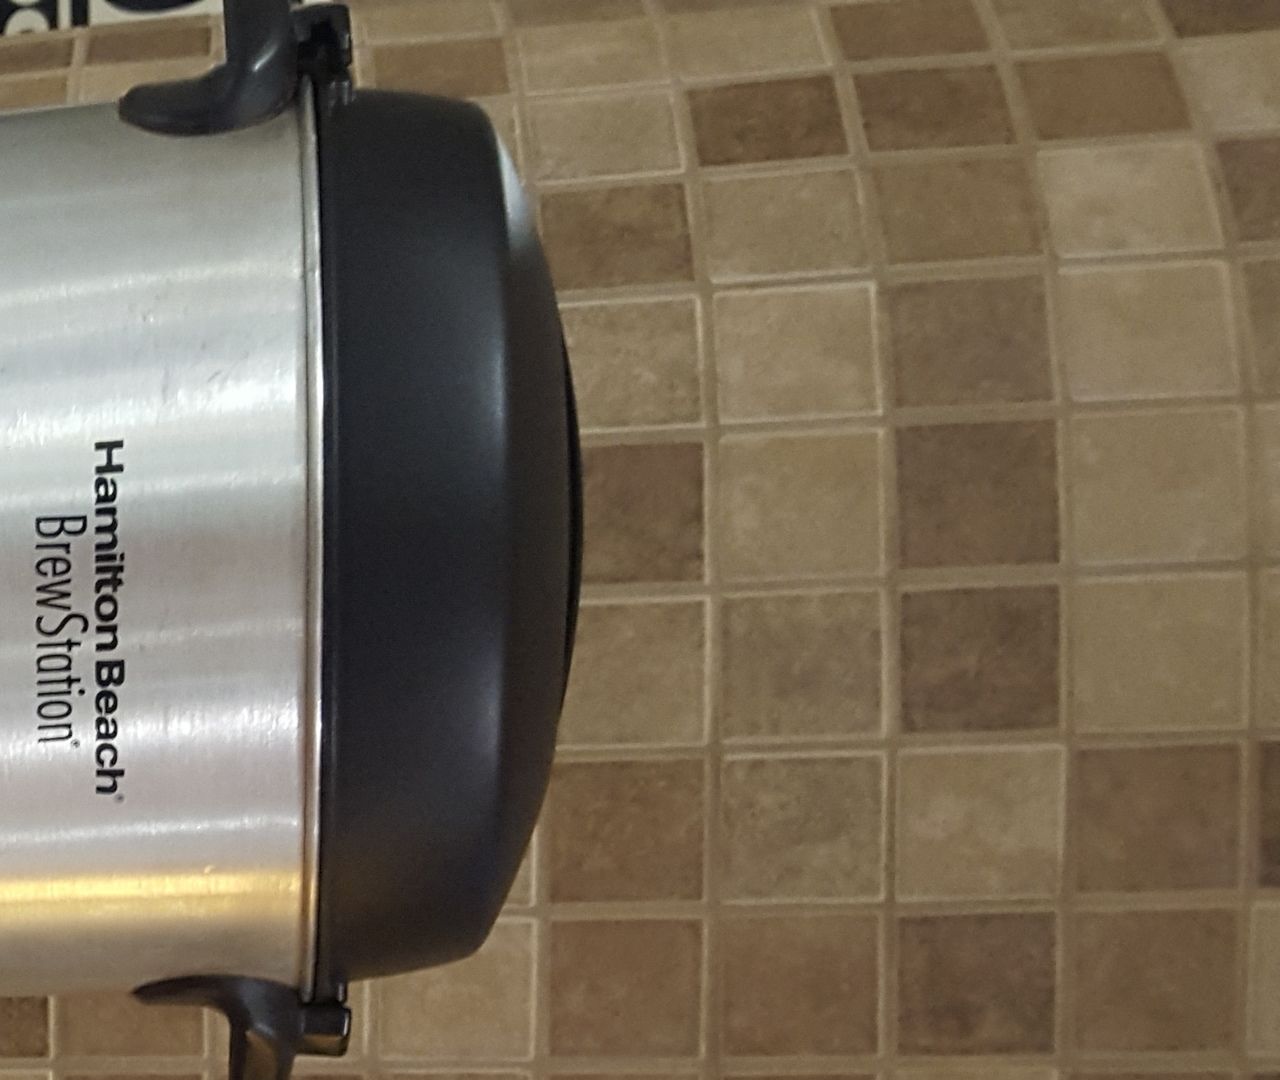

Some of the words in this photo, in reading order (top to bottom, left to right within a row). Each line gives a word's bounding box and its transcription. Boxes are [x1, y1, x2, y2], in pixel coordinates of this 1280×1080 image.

[34, 515, 89, 744] BrewStation
[94, 439, 125, 652] Hamilton
[94, 659, 125, 796] Beach
